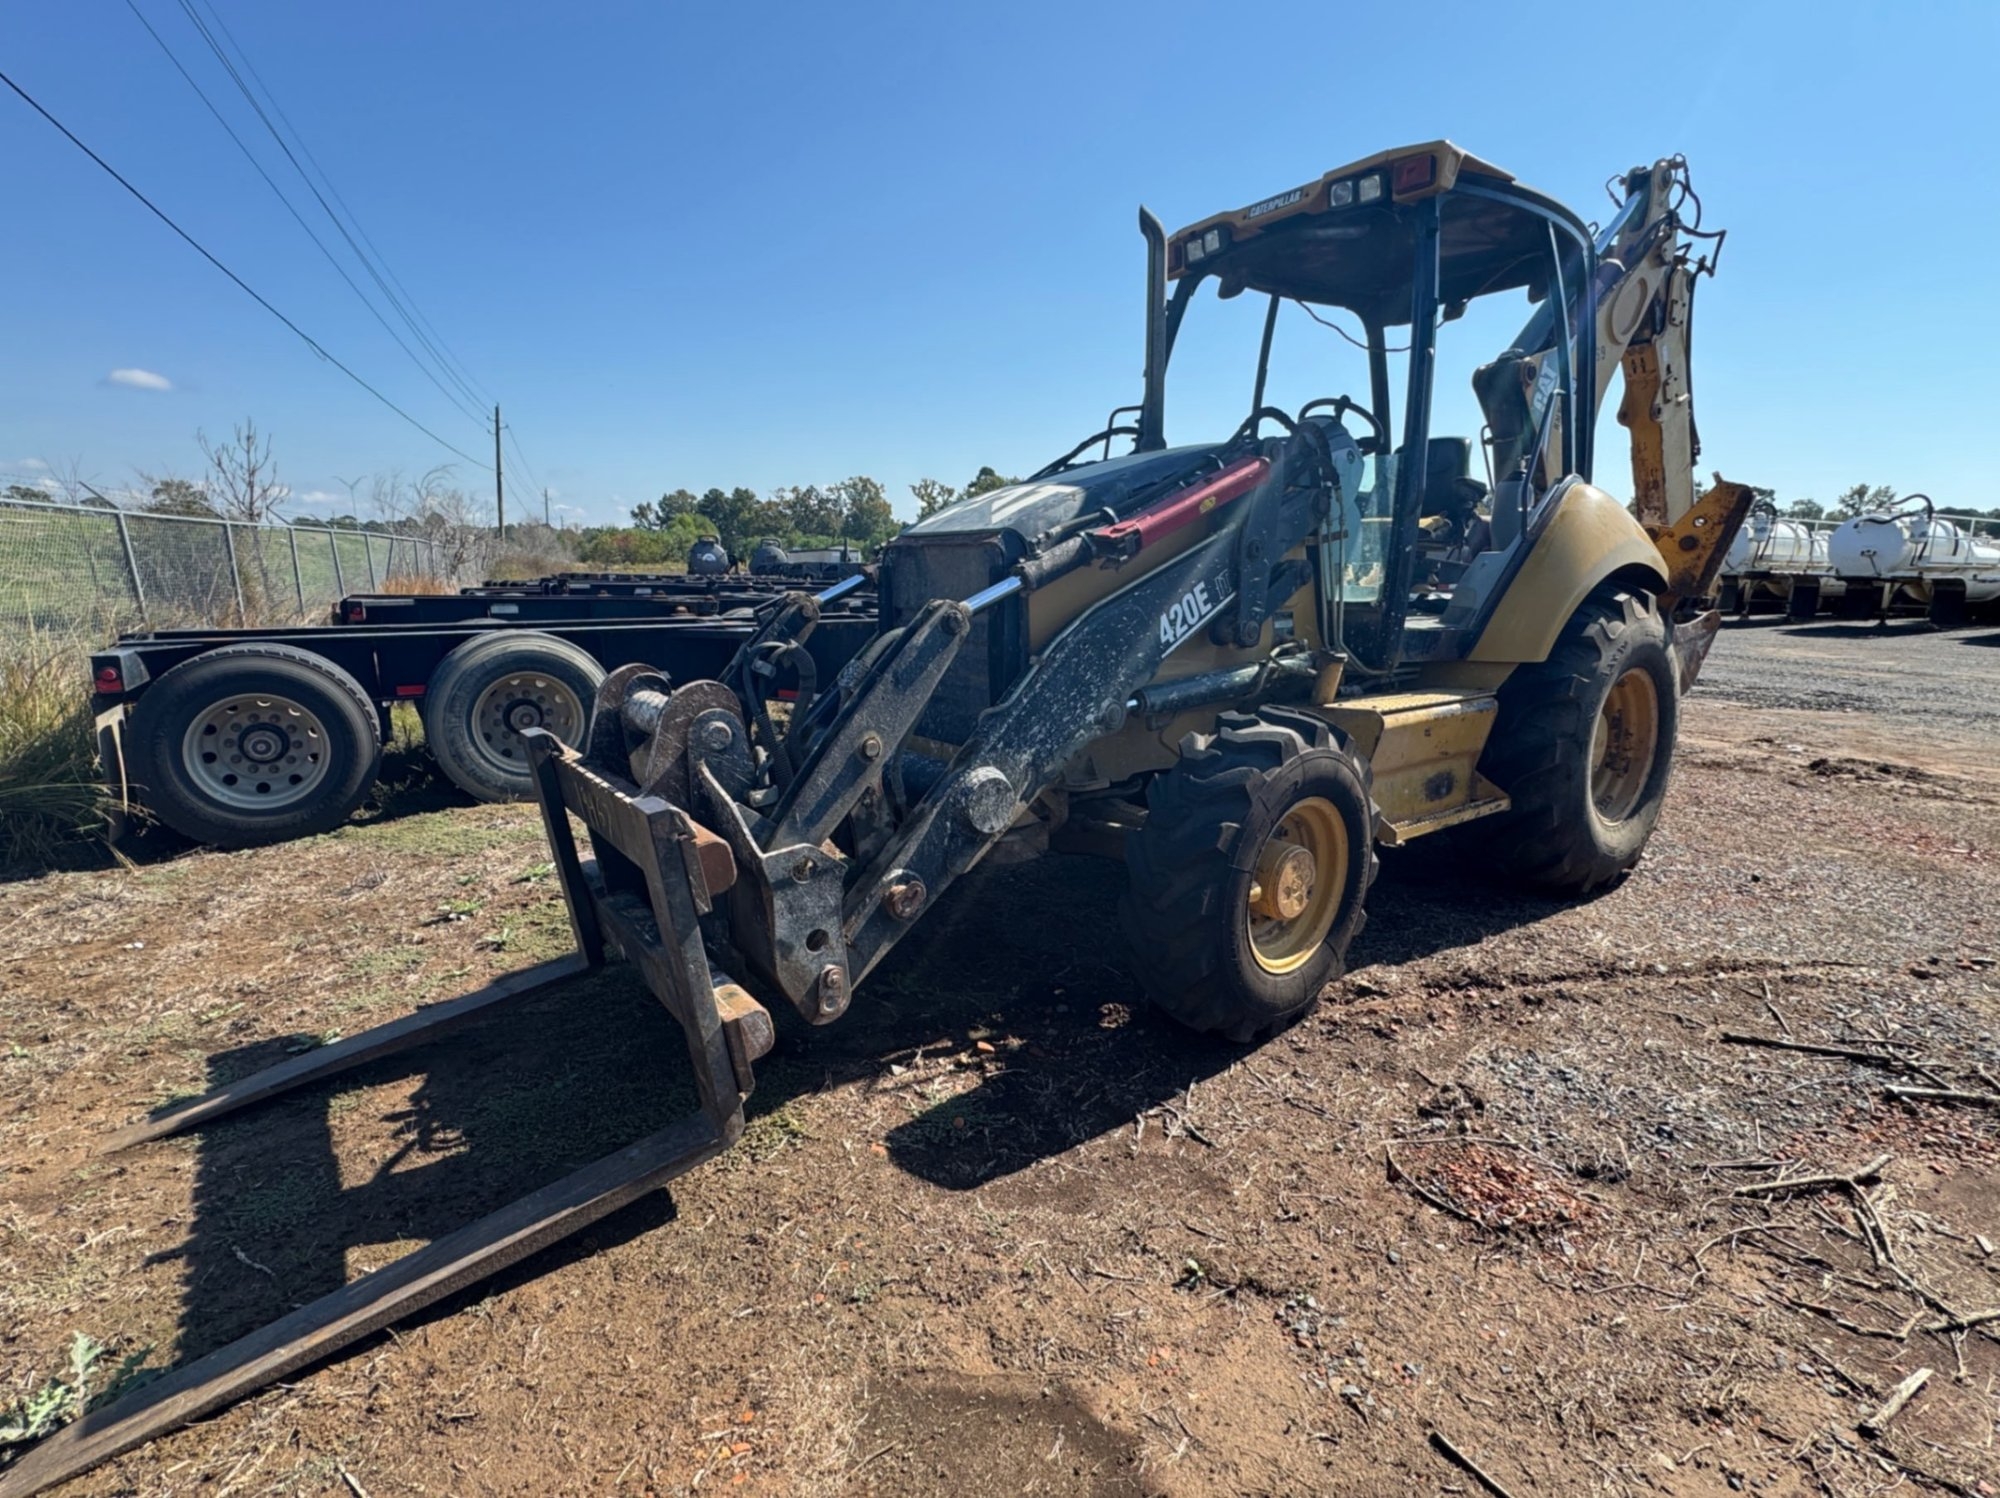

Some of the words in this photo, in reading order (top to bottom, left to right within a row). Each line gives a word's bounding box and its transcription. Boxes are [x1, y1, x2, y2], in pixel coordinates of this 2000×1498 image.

[1249, 190, 1302, 218] CATERPILLAR
[1533, 359, 1558, 412] CAT
[1159, 581, 1212, 644] 420E
